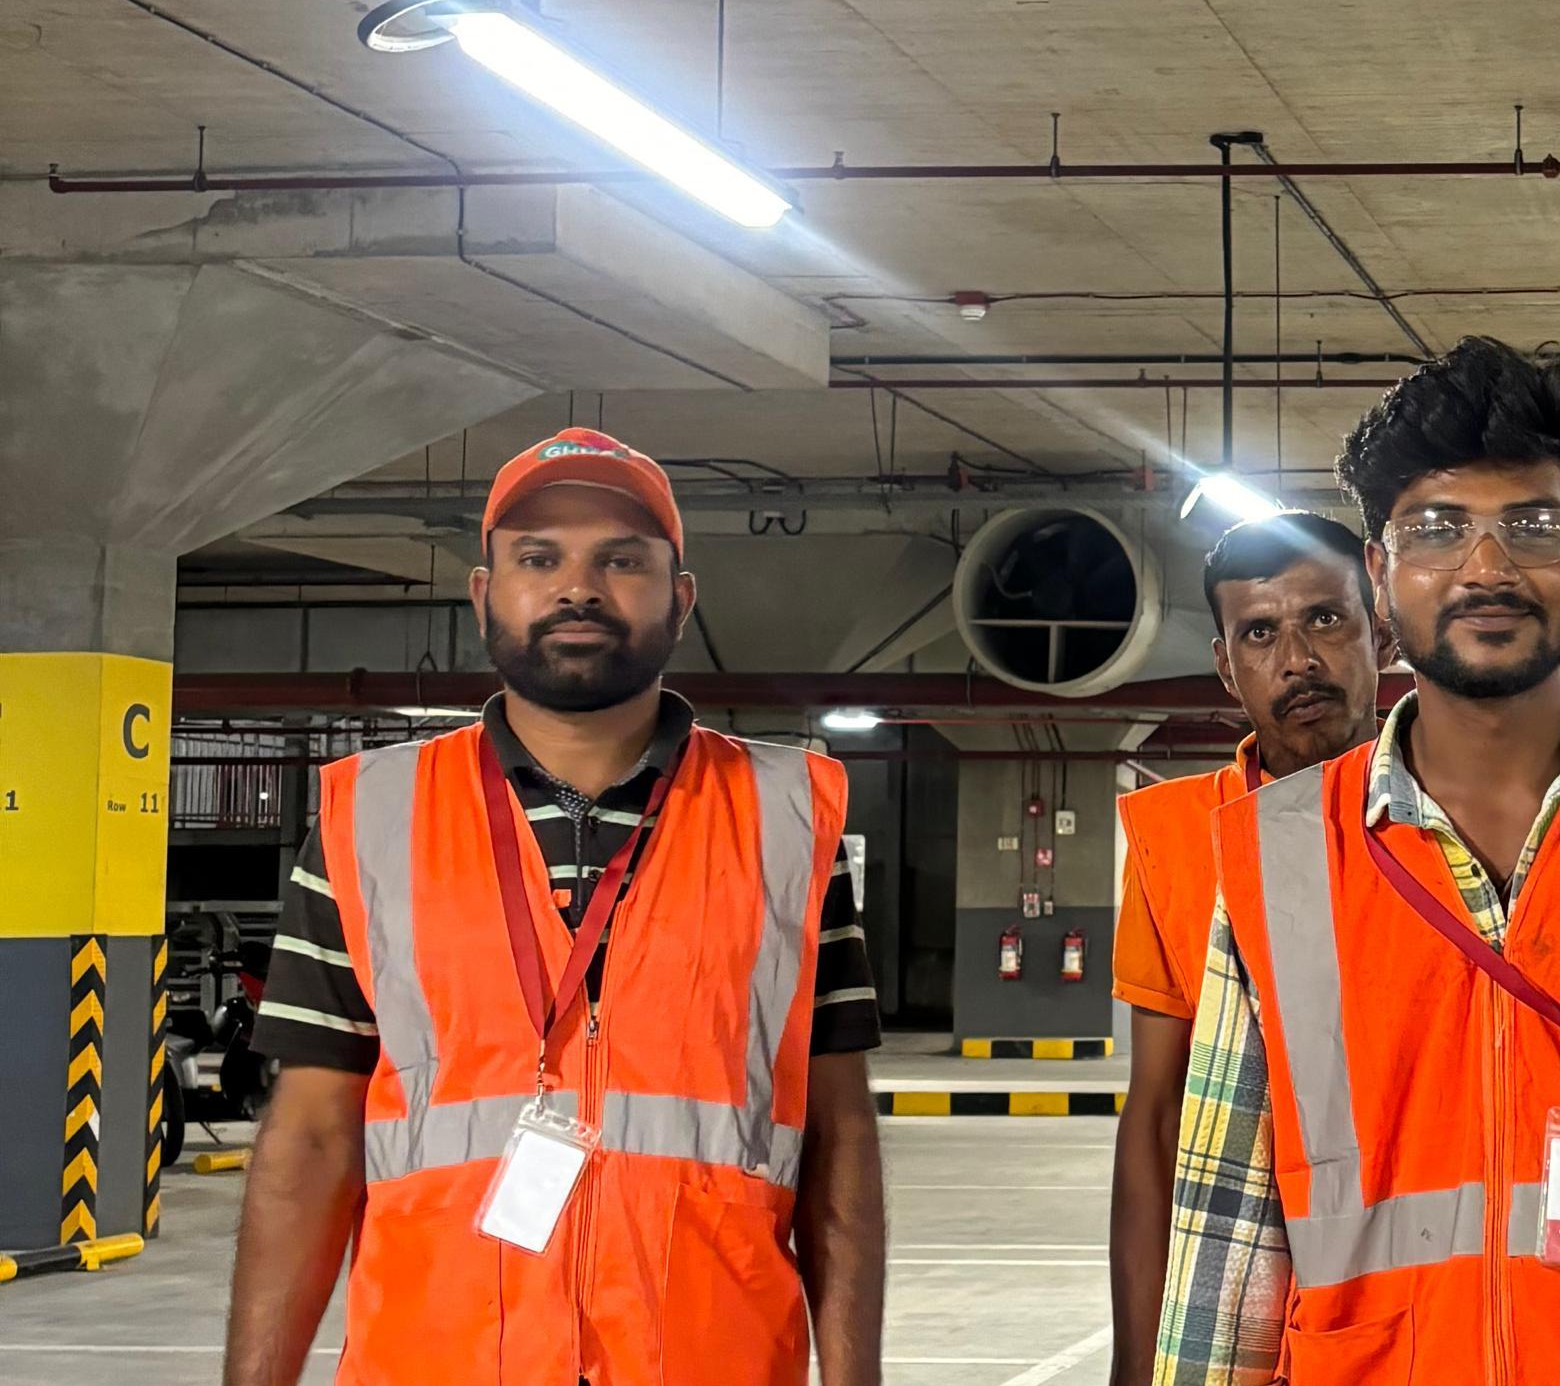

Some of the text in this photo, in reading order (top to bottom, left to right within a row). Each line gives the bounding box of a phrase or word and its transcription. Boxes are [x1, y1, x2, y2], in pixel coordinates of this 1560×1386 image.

[123, 703, 150, 759] C
[0, 790, 19, 811] 1
[107, 792, 159, 813] Row 11
